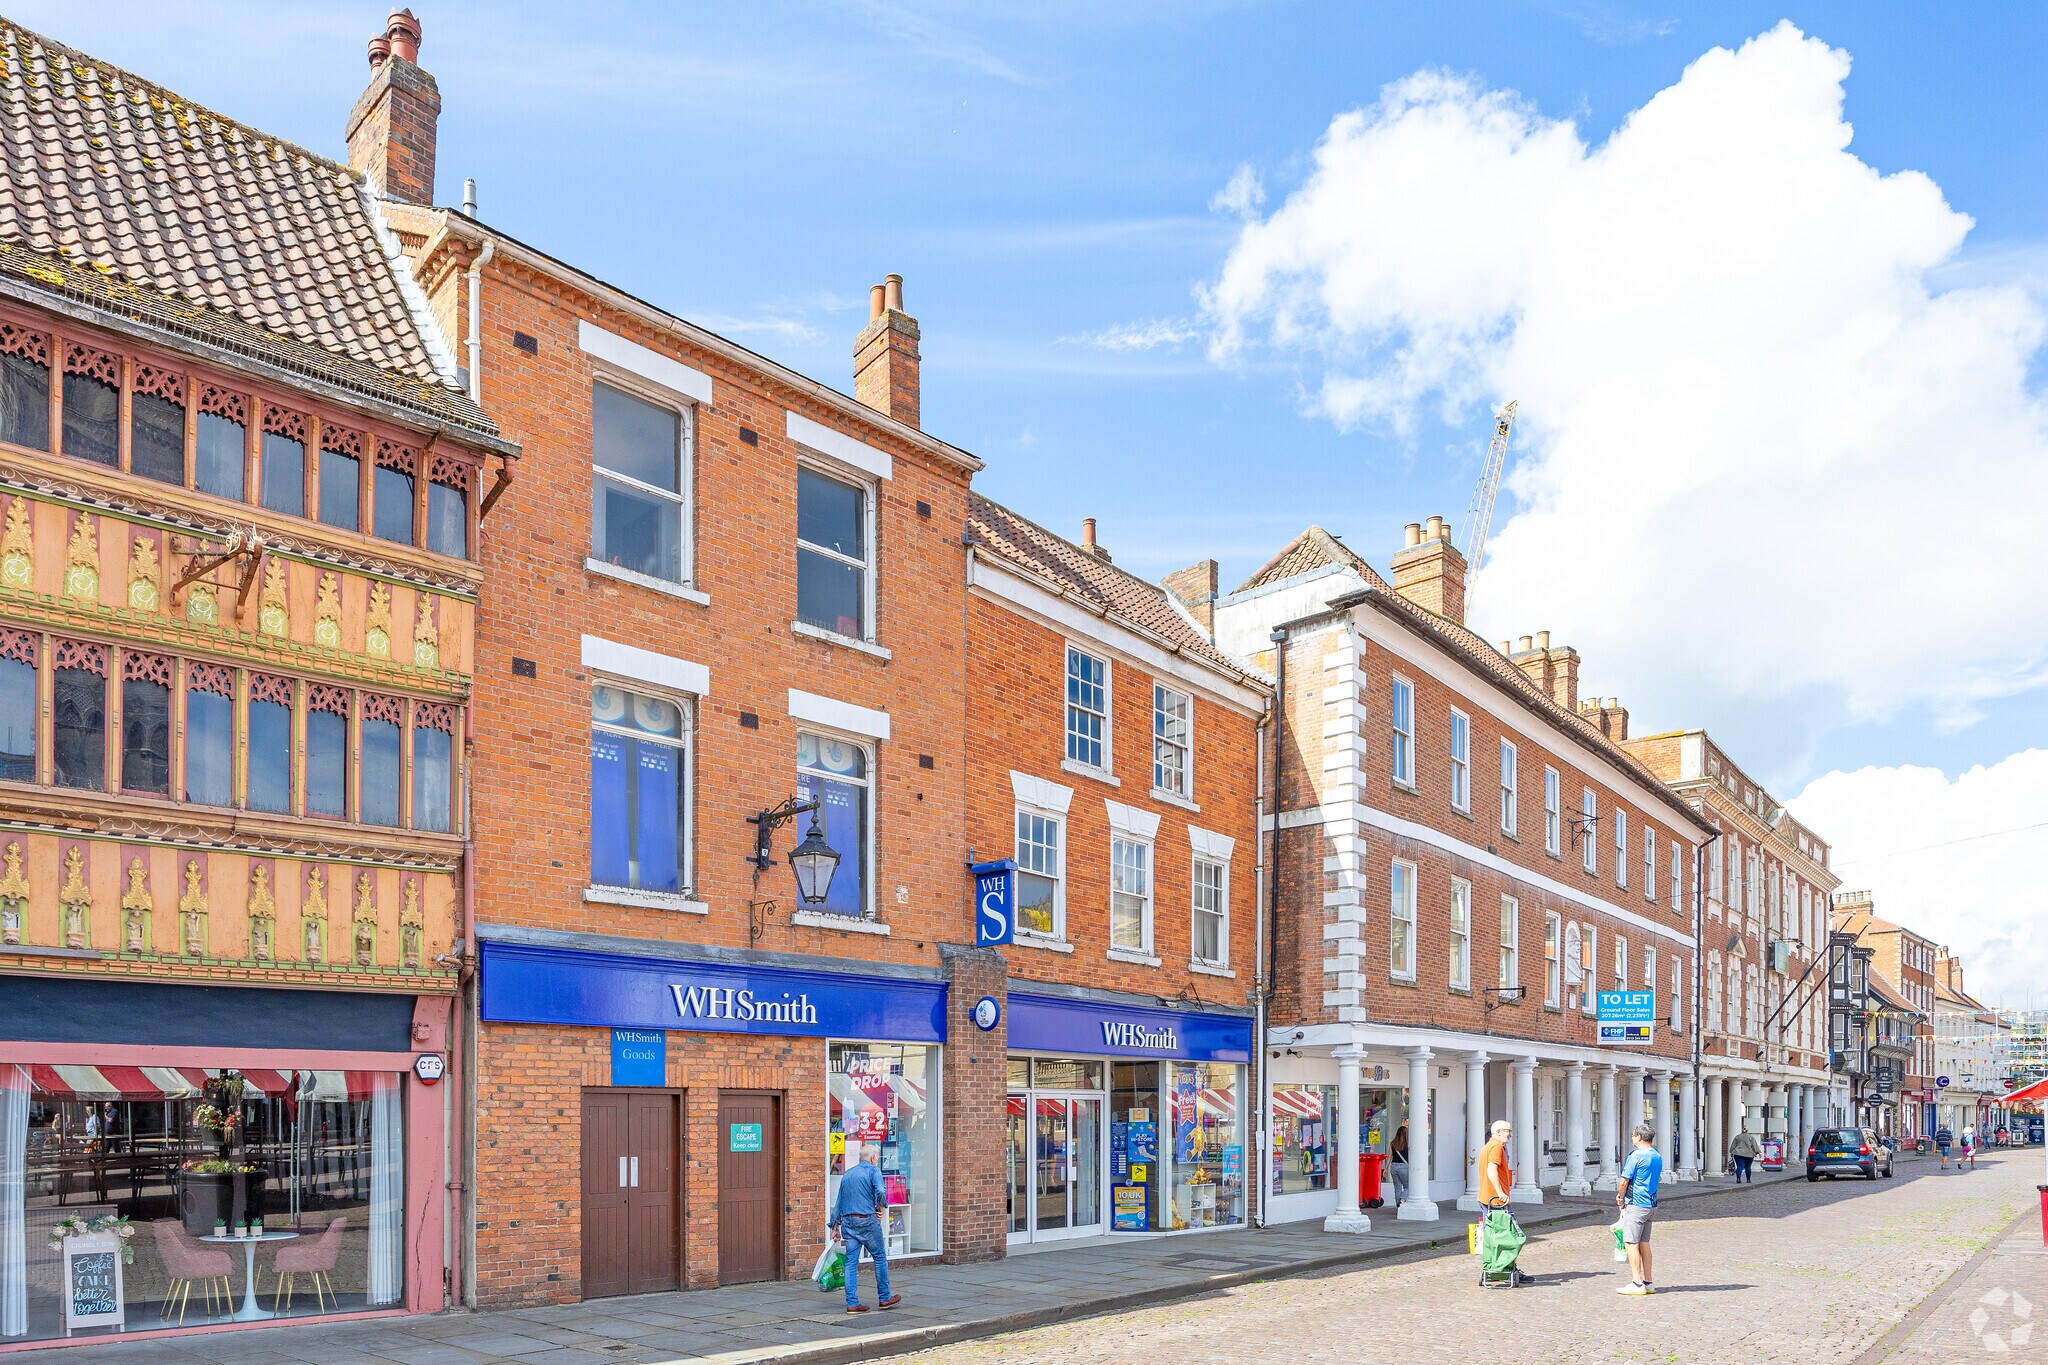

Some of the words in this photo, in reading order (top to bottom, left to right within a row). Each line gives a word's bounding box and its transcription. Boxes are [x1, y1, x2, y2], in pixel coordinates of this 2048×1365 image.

[981, 876, 1006, 892] WH
[982, 891, 1007, 941] S
[669, 984, 818, 1024] WHSmith
[1601, 994, 1621, 1005] TO
[1625, 994, 1650, 1005] LET
[616, 1031, 662, 1044] WHSmith
[1103, 1021, 1177, 1050] WHSmith
[622, 1048, 656, 1061] Goods
[420, 1060, 440, 1070] CFS
[850, 1057, 892, 1074] PRICE
[850, 1074, 891, 1091] DROP
[860, 1112, 870, 1129] 3
[875, 1112, 885, 1130] 2
[1118, 1191, 1128, 1199] 10
[1129, 1191, 1142, 1199] UK
[74, 1257, 113, 1273] Coffee
